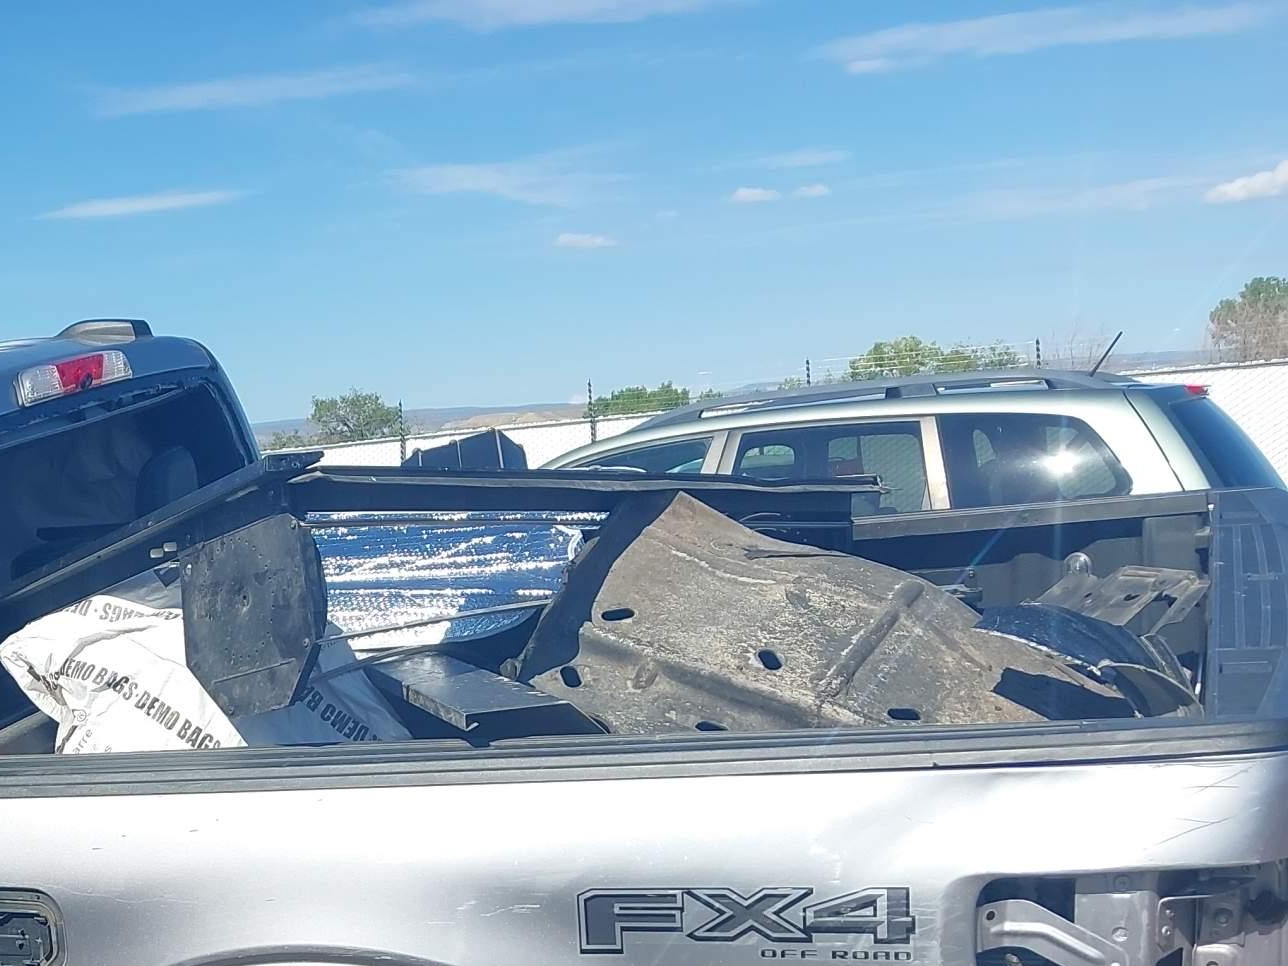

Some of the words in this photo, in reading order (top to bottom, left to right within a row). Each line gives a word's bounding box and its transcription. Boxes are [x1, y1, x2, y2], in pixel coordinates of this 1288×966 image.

[92, 667, 138, 701] BAGS
[134, 690, 180, 730] DEMO
[578, 887, 916, 955] FX4
[761, 949, 817, 959] OFF
[832, 950, 913, 961] ROAD
